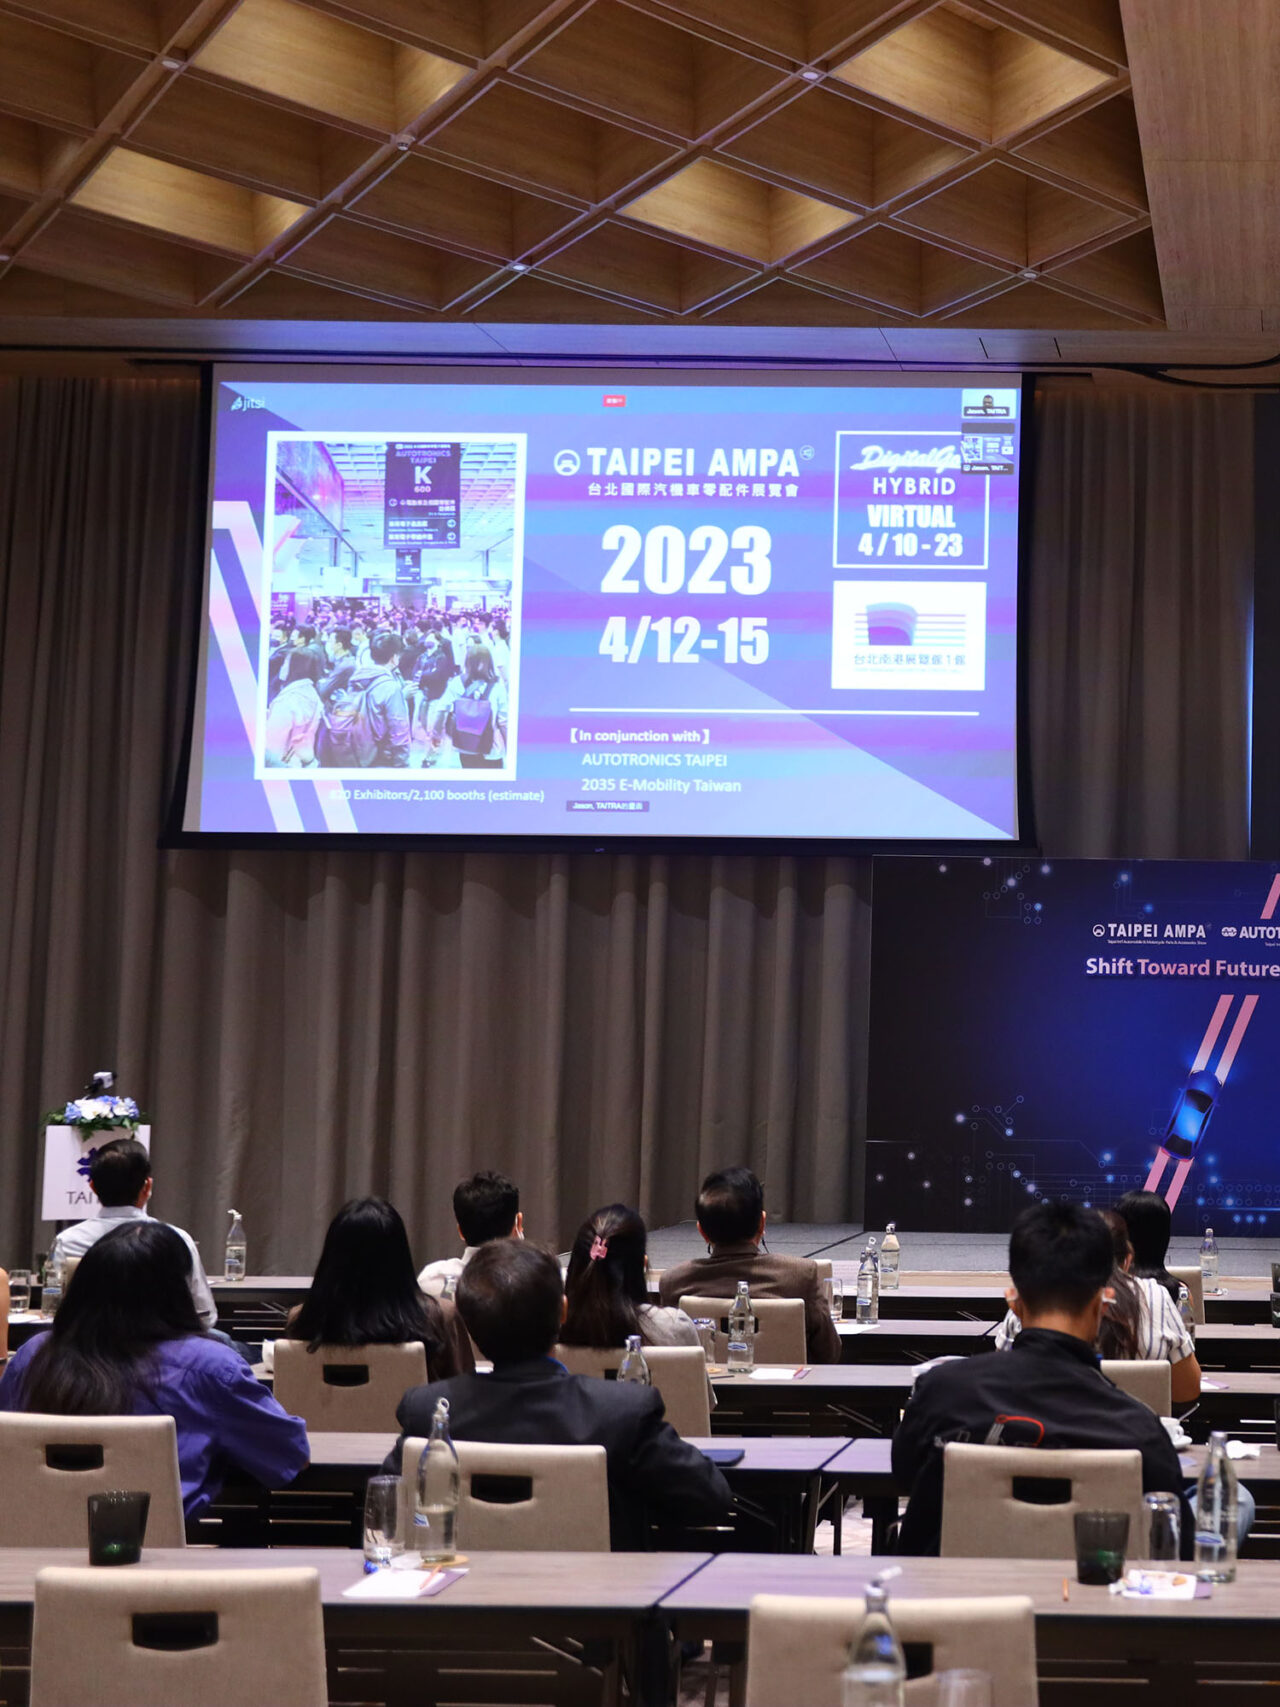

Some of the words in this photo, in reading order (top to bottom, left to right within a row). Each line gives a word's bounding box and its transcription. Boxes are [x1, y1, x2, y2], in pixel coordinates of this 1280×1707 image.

[587, 448, 695, 476] TAIPEI
[708, 448, 800, 478] AMPA
[414, 466, 432, 484] K
[873, 477, 956, 495] HYBRID
[867, 504, 956, 528] VIRTUAL
[601, 524, 772, 596] 2023
[599, 616, 770, 665] 4/12-15
[595, 730, 668, 744] conjunction
[582, 753, 681, 767] AUTOTRONICS
[685, 754, 727, 767] TAIPEI
[581, 778, 616, 791] 2035
[619, 778, 690, 794] E-Mobility
[693, 780, 741, 792] Taiwan
[354, 789, 444, 802] Exhibitors/2,100
[447, 790, 485, 800] booths
[488, 790, 544, 803] (estimate)
[1108, 923, 1158, 937] TAIPEI
[1164, 924, 1206, 938] AMPA
[1086, 958, 1133, 975] Shift
[1137, 958, 1210, 976] Toward
[1215, 960, 1280, 976] Future
[66, 1191, 101, 1204] TAI
